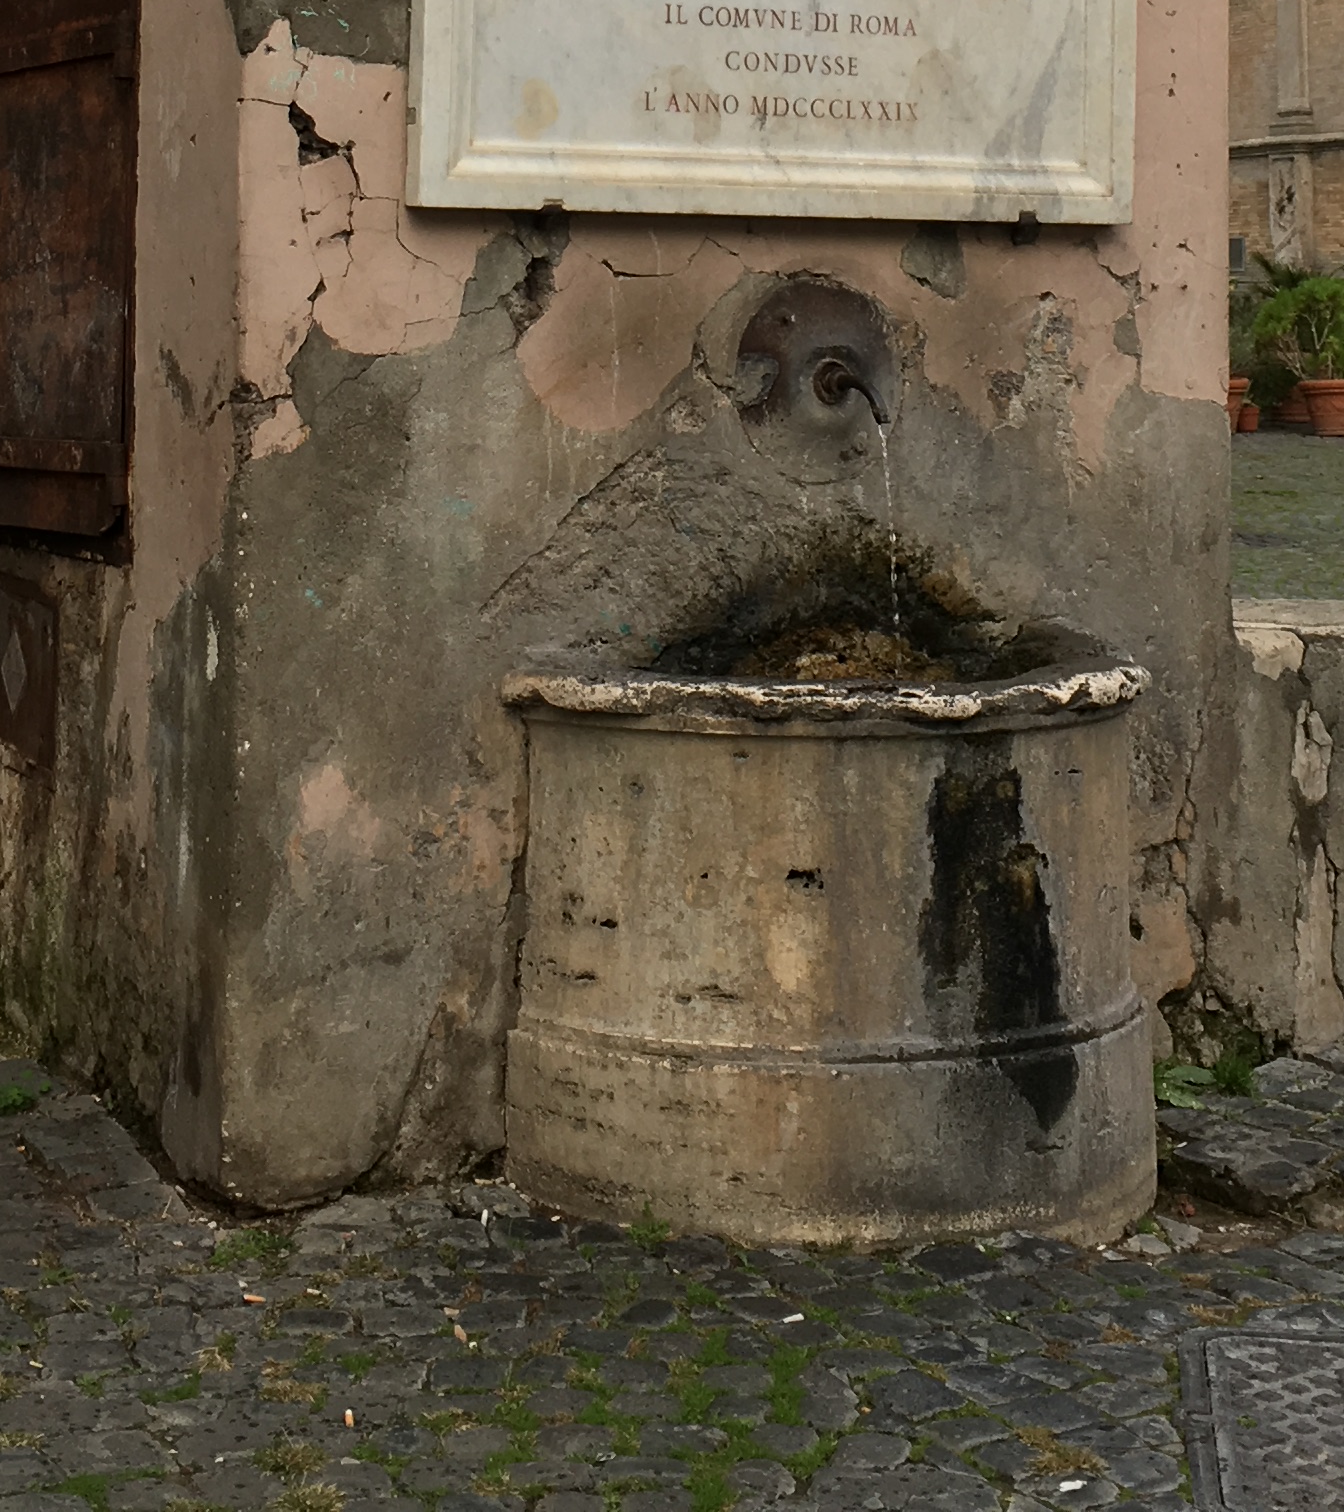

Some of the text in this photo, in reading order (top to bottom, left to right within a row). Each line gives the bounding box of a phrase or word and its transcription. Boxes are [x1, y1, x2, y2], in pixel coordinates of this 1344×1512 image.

[664, 3, 918, 37] IL COMVNE DI ROMA
[724, 50, 859, 77] CONDVSSE
[750, 95, 919, 122] MDCCCLXXIX
